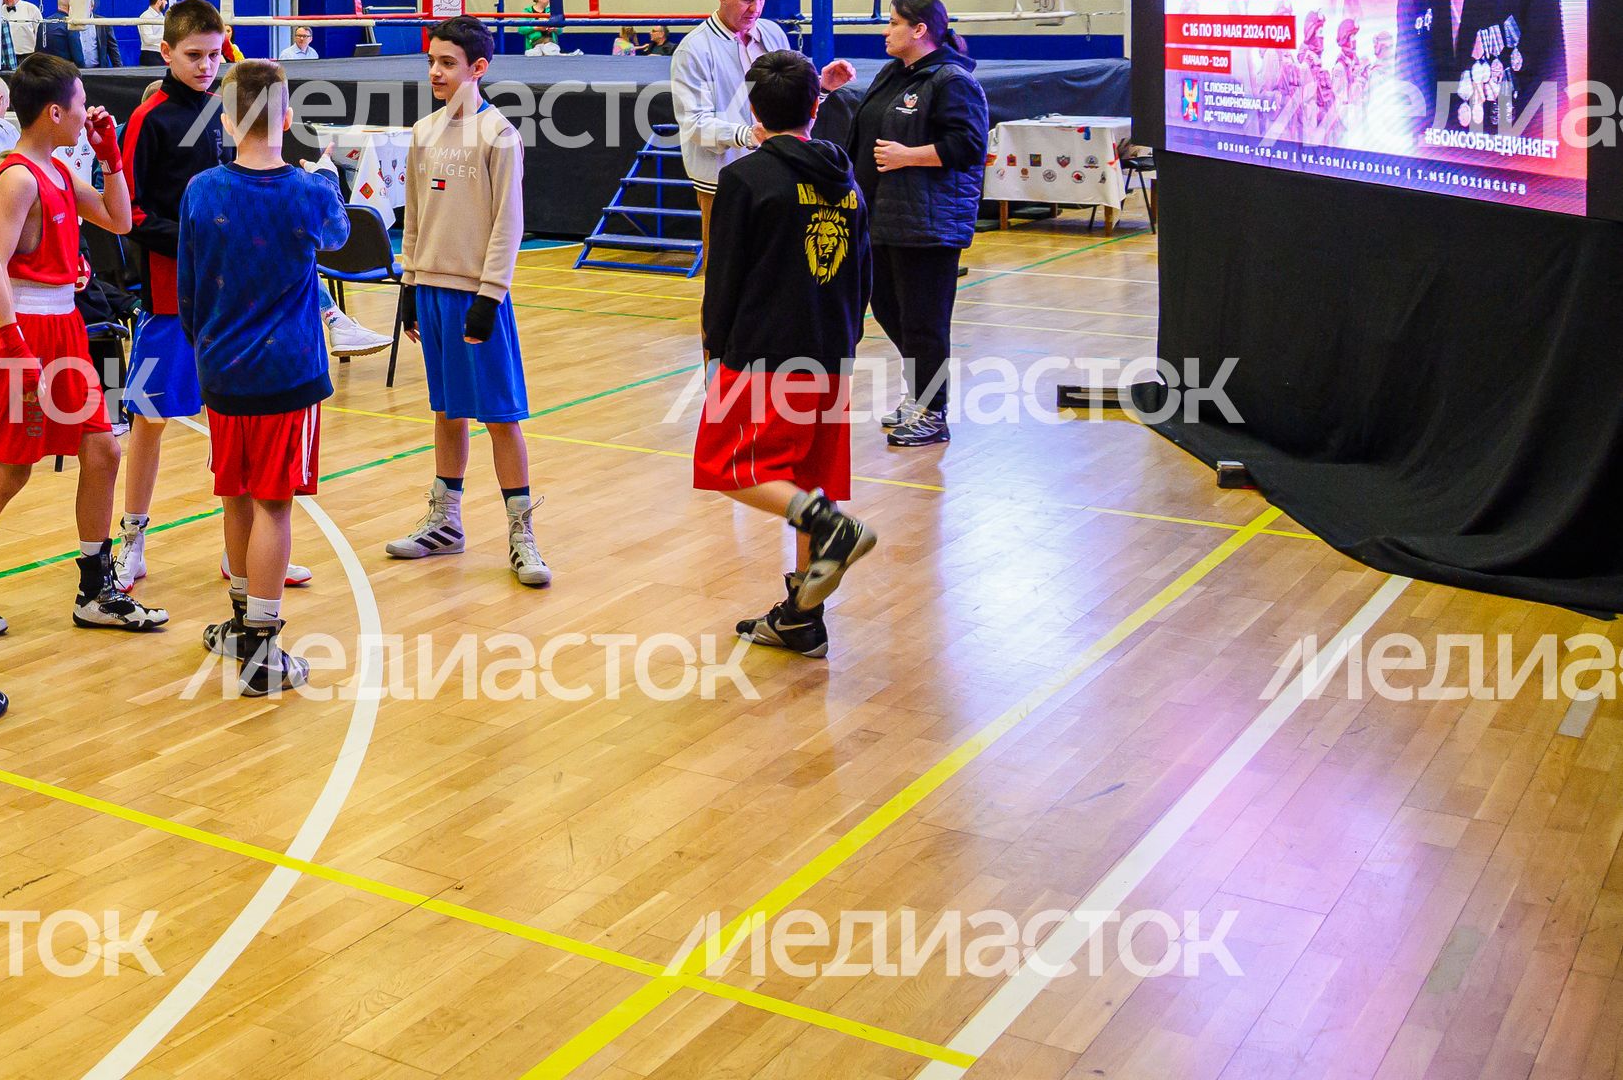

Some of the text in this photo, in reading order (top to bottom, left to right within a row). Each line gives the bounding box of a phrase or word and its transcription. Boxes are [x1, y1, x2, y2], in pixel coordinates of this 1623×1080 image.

[1182, 22, 1291, 43] С 16 ПО 18 МАЯ 2024 ГОДА
[1182, 54, 1209, 67] НАЧАЛО
[1212, 55, 1229, 68] 12:00
[1424, 128, 1560, 159] #БОКСОБЪЕДИНЯЕТ
[1217, 141, 1527, 195] BOXING-LFB.RU VK.COM/LFBOXING T.ME/BOXINGLFB
